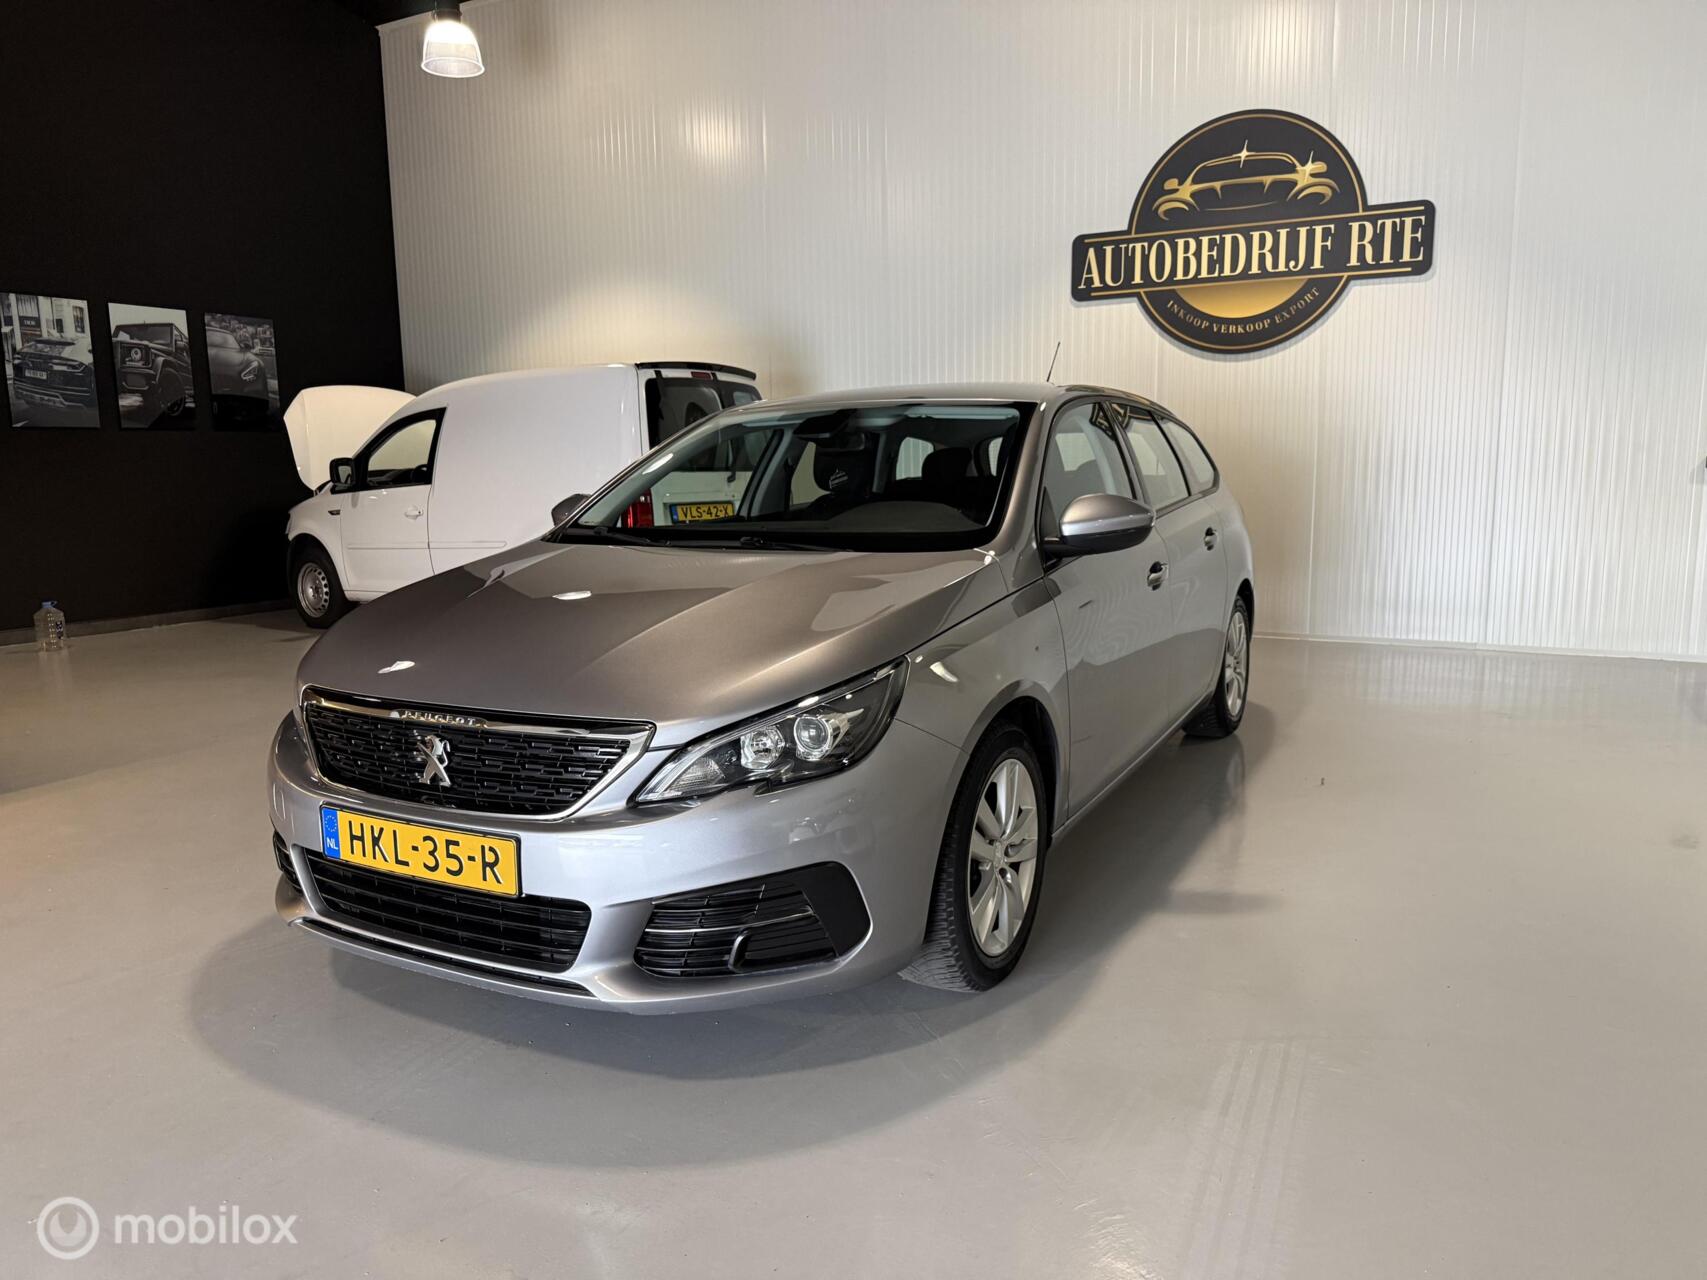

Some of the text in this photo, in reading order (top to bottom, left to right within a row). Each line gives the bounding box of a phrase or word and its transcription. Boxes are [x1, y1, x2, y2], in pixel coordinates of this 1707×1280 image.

[1077, 215, 1426, 289] AUTOBEDRIJF RTE
[1167, 287, 1321, 334] INKOOP VERKOOP EXPORT
[681, 505, 729, 519] VLS-42-X
[404, 710, 476, 727] PEUGEOT
[326, 820, 503, 884] NL HKL-35-R
